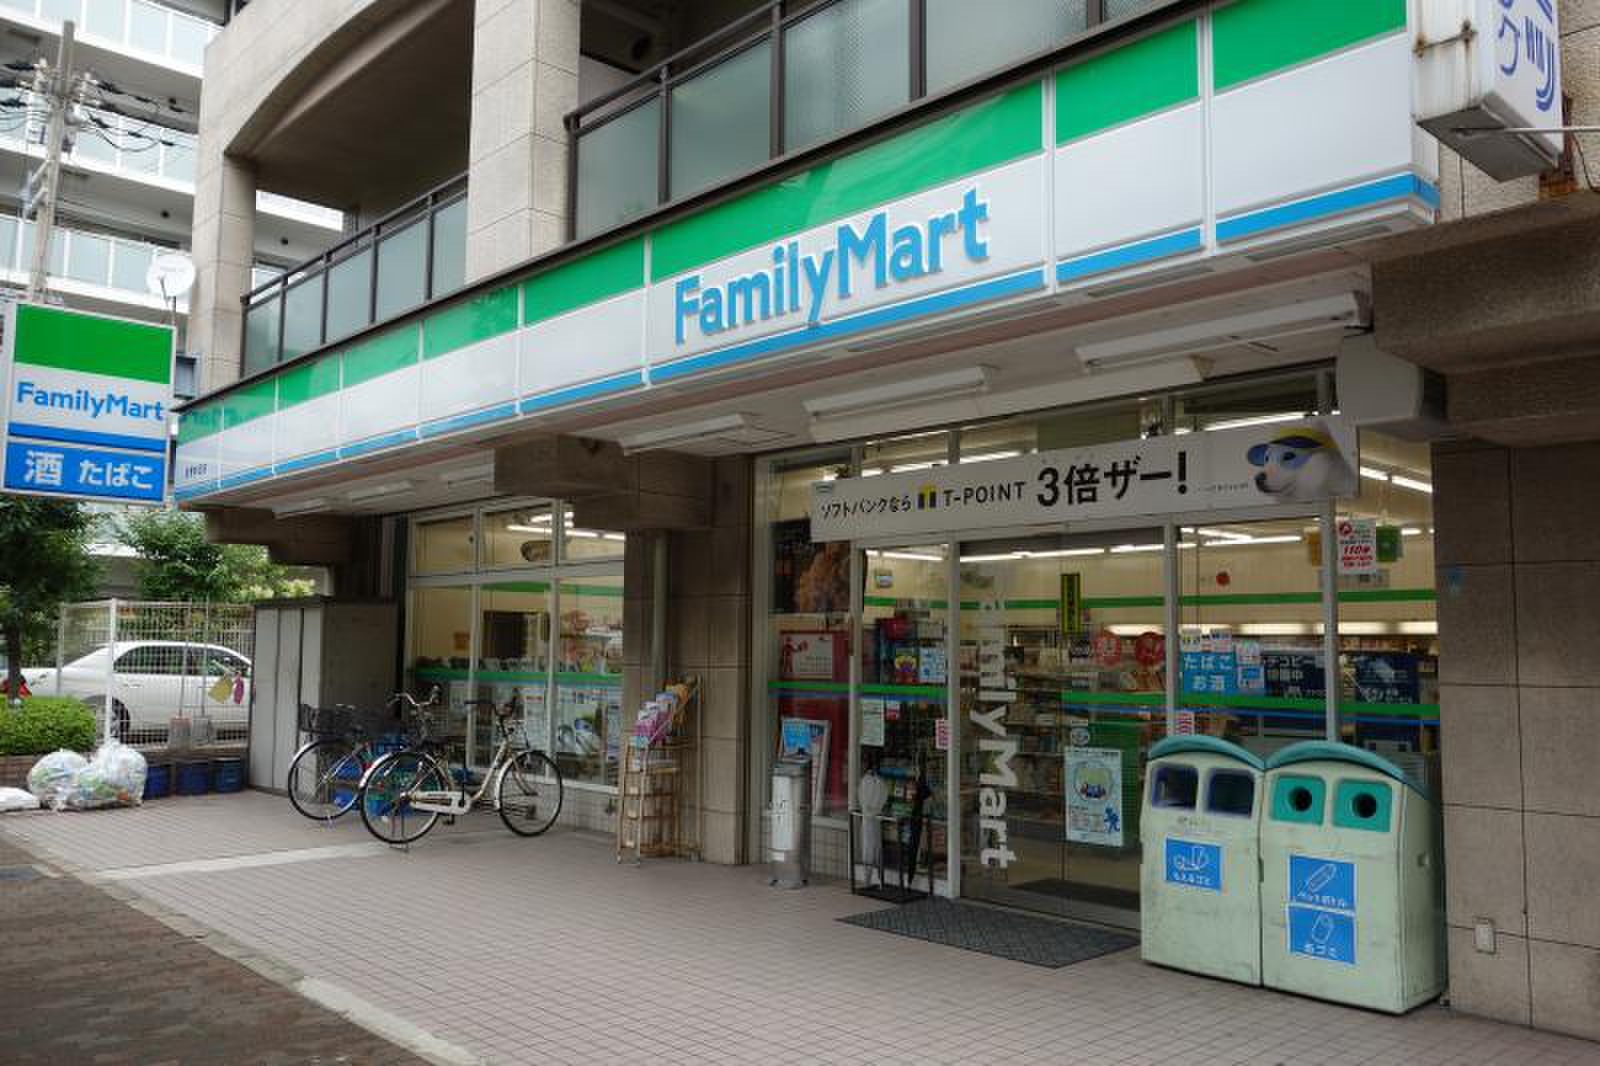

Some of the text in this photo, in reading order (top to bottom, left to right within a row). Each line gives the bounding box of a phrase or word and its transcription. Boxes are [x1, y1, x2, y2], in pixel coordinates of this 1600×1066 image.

[675, 188, 989, 345] FamilyMart
[17, 382, 164, 421] FamilyMart
[24, 451, 65, 486] 酒
[78, 459, 154, 490] たばこ
[822, 494, 911, 519] ソフトバンクなら
[943, 481, 1026, 507] T-POINT
[1184, 653, 1233, 670] たばこ
